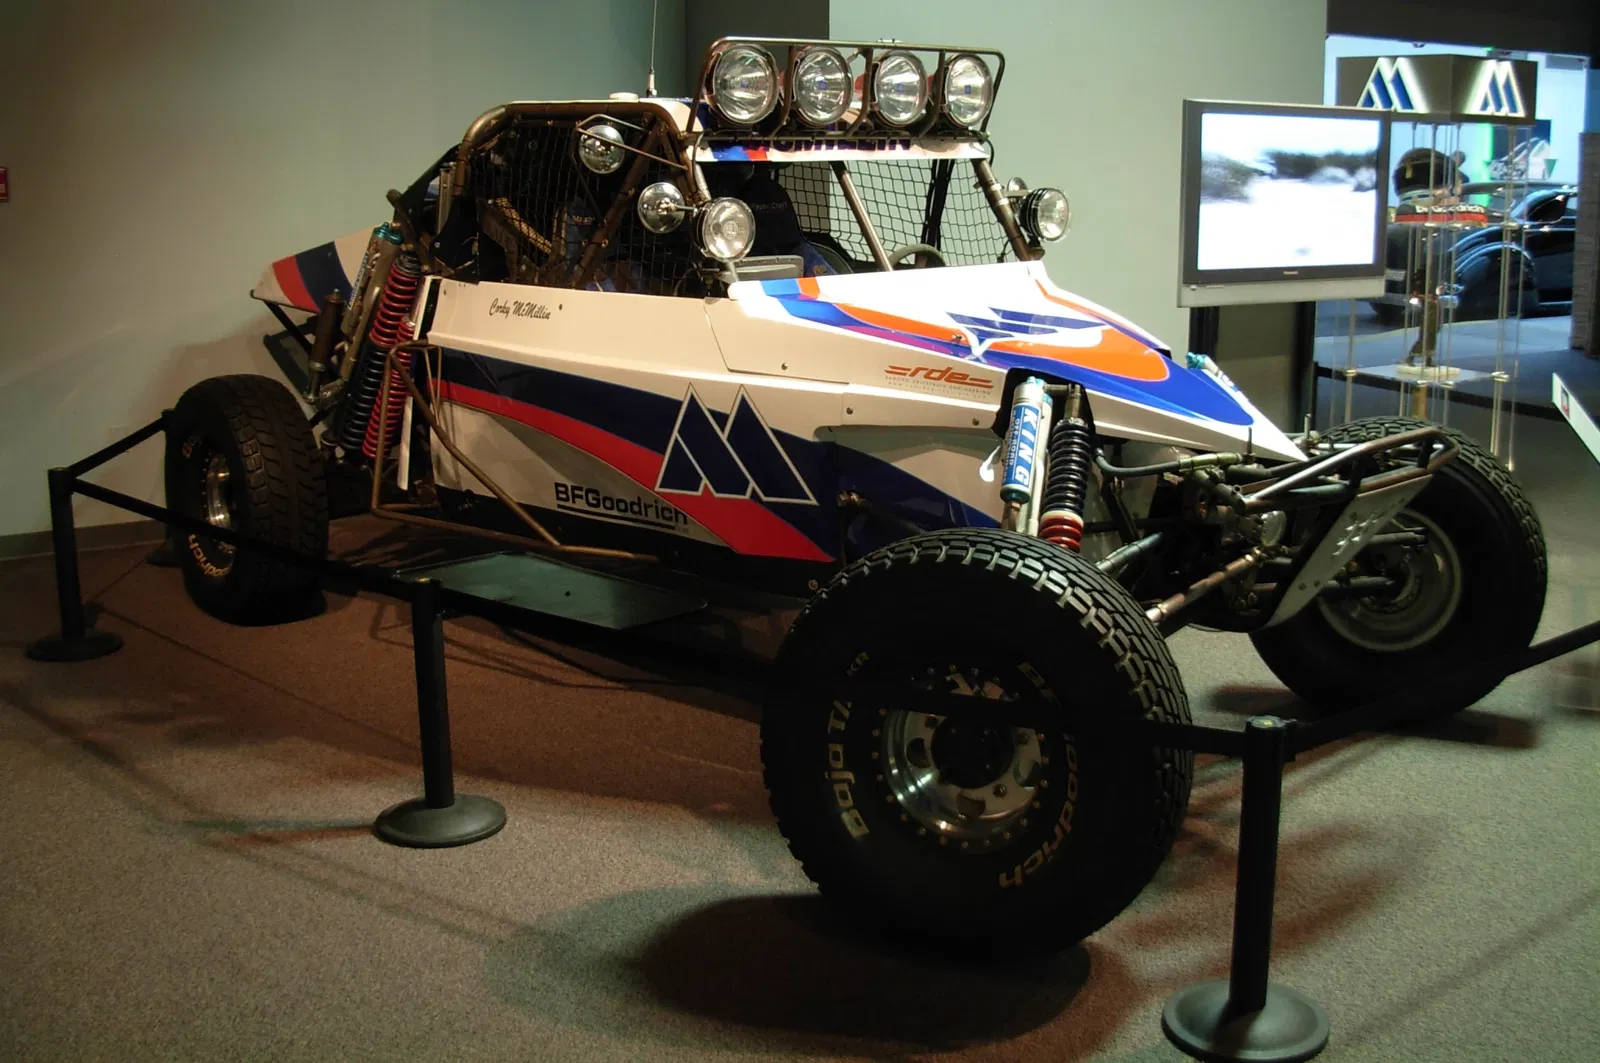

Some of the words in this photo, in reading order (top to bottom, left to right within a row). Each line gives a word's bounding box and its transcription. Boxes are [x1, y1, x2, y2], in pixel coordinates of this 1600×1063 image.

[1014, 408, 1039, 487] KING
[554, 482, 688, 525] BFGoodrich
[825, 742, 870, 839] Baja
